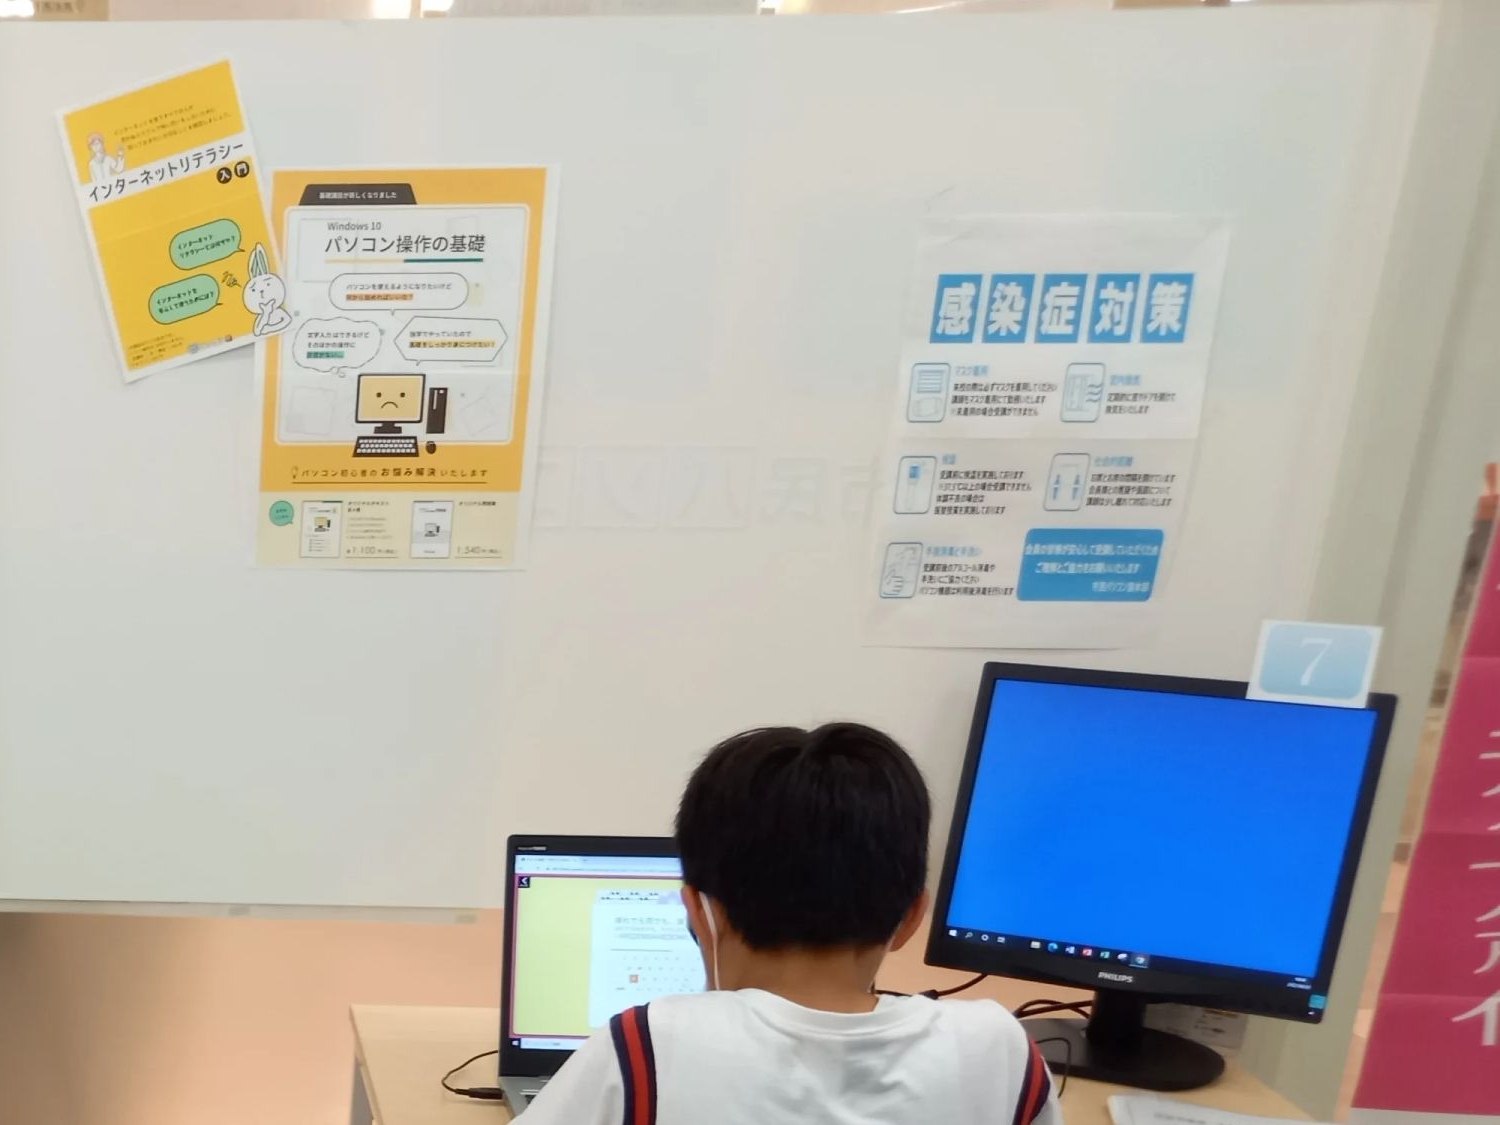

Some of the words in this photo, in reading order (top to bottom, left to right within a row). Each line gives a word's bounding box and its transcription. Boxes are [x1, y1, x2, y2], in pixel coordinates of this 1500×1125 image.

[88, 141, 244, 203] インターネットリテラシー
[217, 161, 250, 184] 入門
[327, 222, 369, 231] Windows
[371, 222, 382, 231] 10
[325, 234, 485, 253] パソコン操作の基礎
[936, 281, 1188, 336] 感染症対策
[1299, 637, 1333, 686] 7
[1098, 971, 1134, 983] PHILIPS
